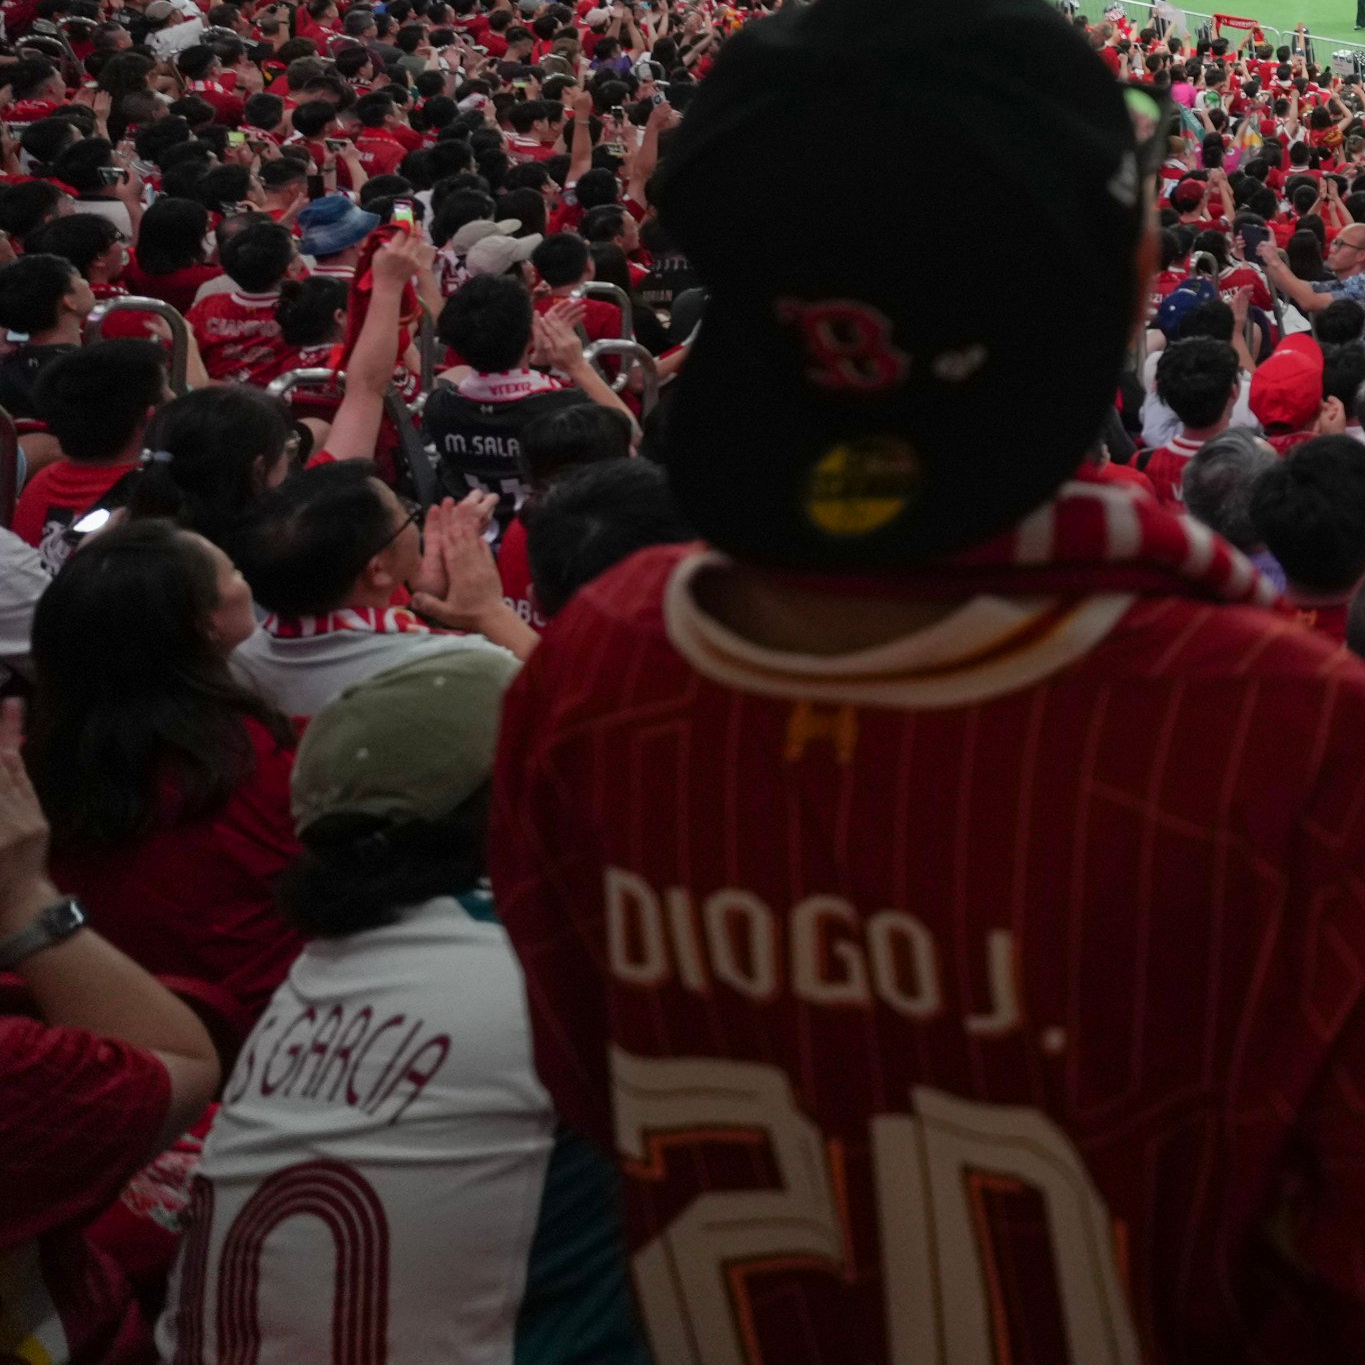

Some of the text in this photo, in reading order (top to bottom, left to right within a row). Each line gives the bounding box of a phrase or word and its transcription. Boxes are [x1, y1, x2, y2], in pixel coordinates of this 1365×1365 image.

[775, 295, 913, 400] B
[445, 433, 520, 457] M.SALA
[605, 865, 1068, 1055] DIOGO J.
[262, 1003, 452, 1125] GARCIA
[610, 1043, 1150, 1365] 20
